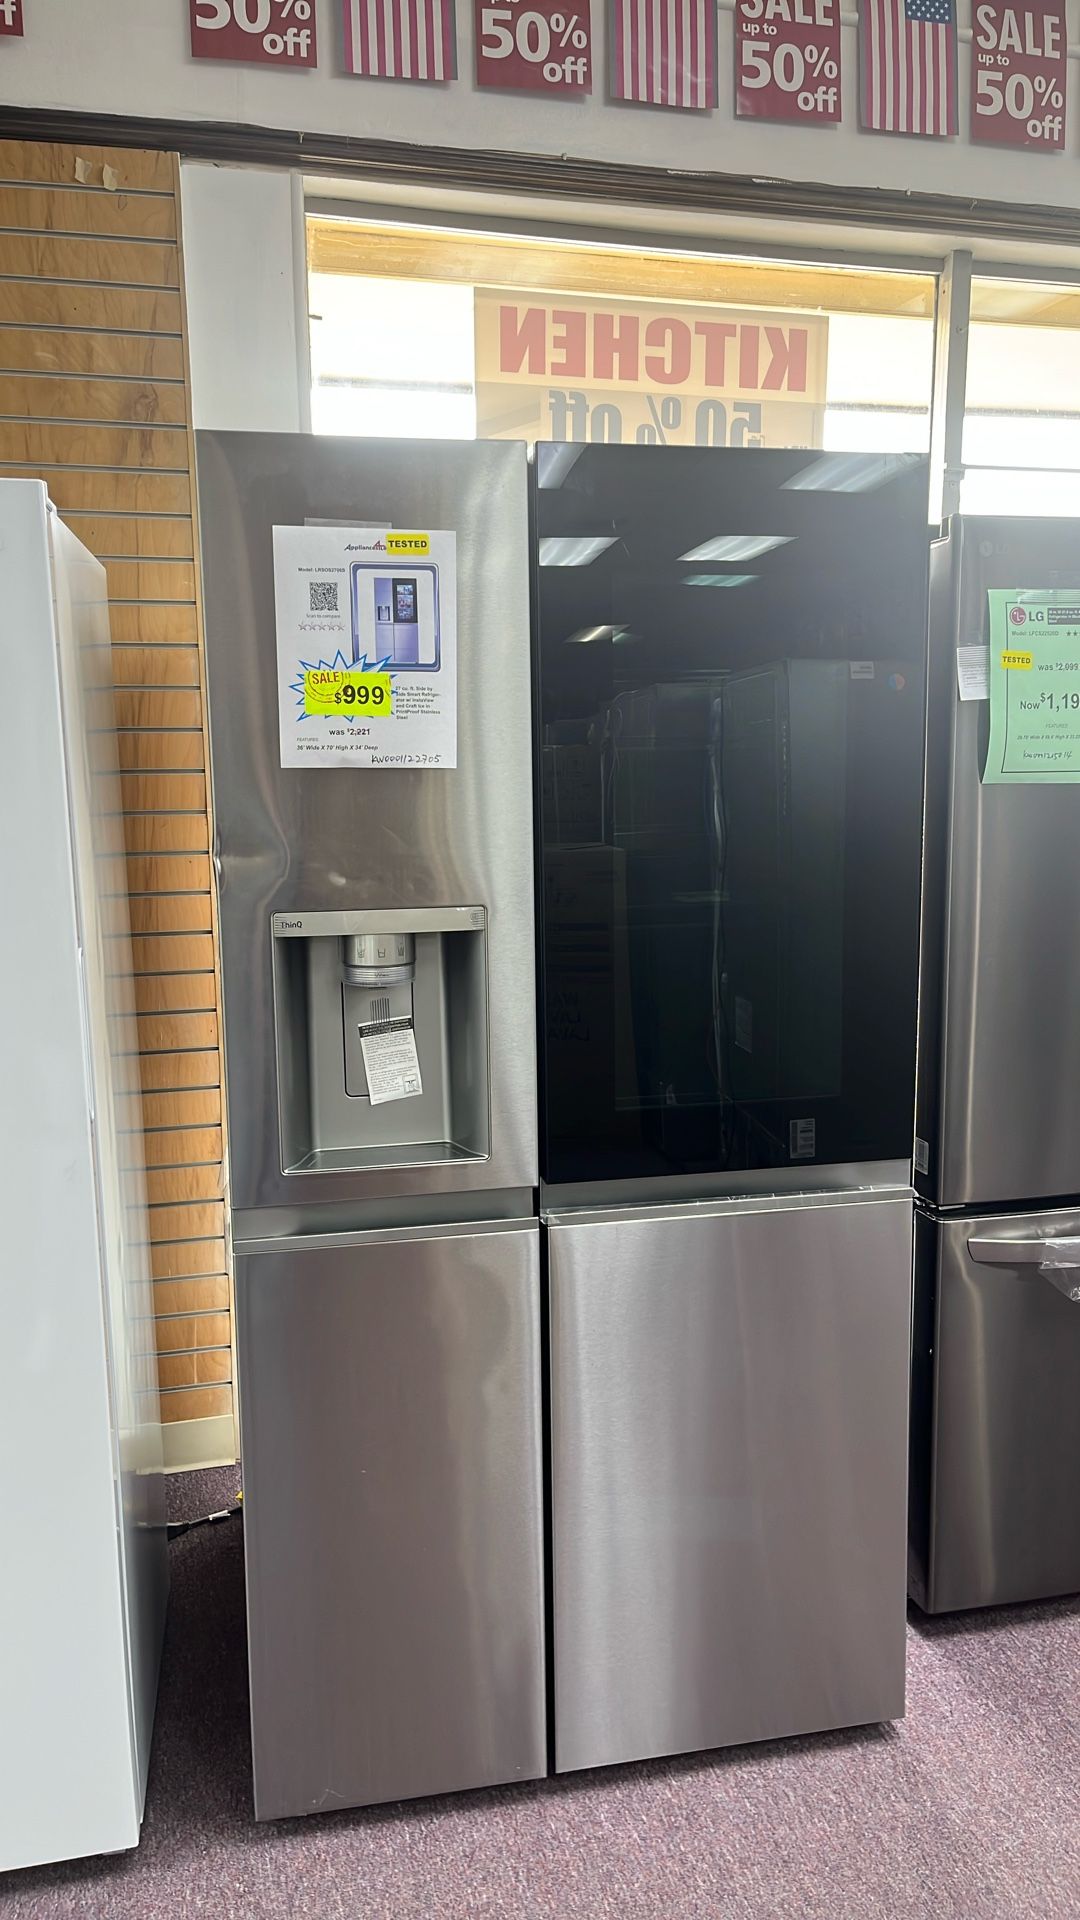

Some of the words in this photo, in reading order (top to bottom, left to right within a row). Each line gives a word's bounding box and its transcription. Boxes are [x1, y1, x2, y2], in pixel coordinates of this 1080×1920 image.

[196, 0, 311, 34] 50%
[481, 8, 588, 63] 50%
[742, 23, 760, 36] up
[762, 23, 778, 36] to
[976, 4, 1061, 60] SALE
[263, 27, 311, 58] off
[543, 56, 588, 85] off
[741, 40, 838, 92] 50%
[978, 53, 994, 66] up
[996, 54, 1010, 66] to
[797, 86, 838, 113] off
[976, 70, 1064, 120] 50%
[1026, 115, 1063, 141] off
[388, 540, 427, 548] TESTED
[1028, 611, 1045, 622] LG
[1002, 656, 1031, 664] TESTED
[311, 671, 341, 685] SALE
[334, 684, 385, 706] $999
[1020, 700, 1040, 710] Now
[281, 920, 303, 929] ThinQ
